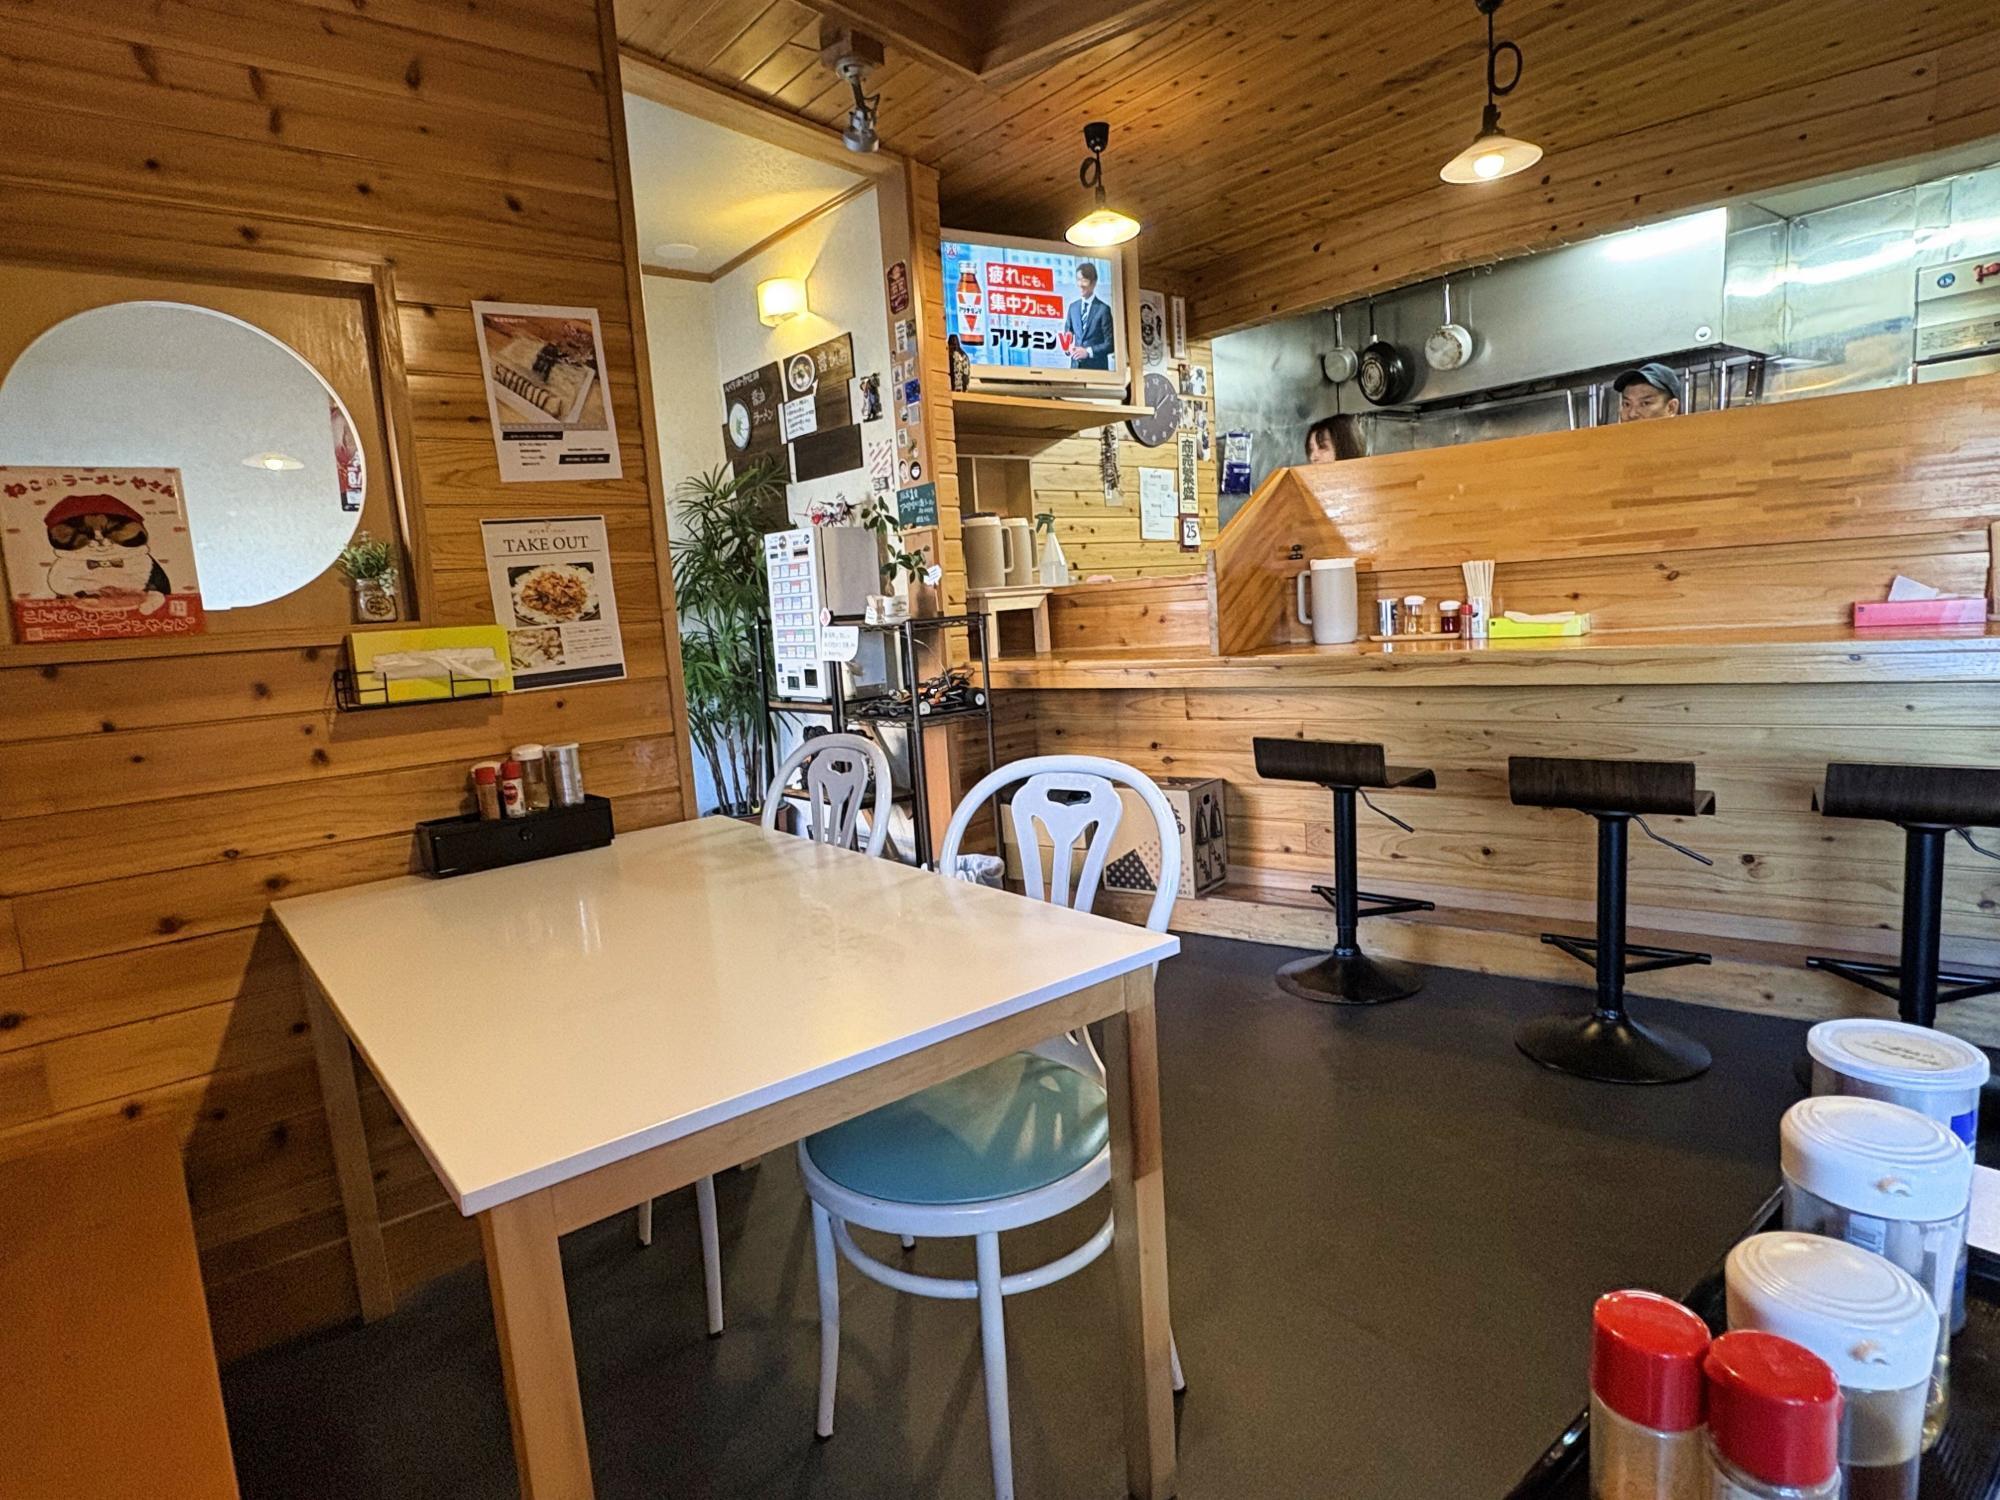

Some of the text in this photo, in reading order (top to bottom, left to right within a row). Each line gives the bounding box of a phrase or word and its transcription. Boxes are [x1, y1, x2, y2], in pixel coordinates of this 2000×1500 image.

[988, 265, 1046, 289] 疲れにも、
[990, 293, 1062, 317] 集中力にも、
[990, 327, 1074, 352] アリナミンV
[1185, 524, 1198, 539] 25
[503, 535, 589, 553] TAKE OUT
